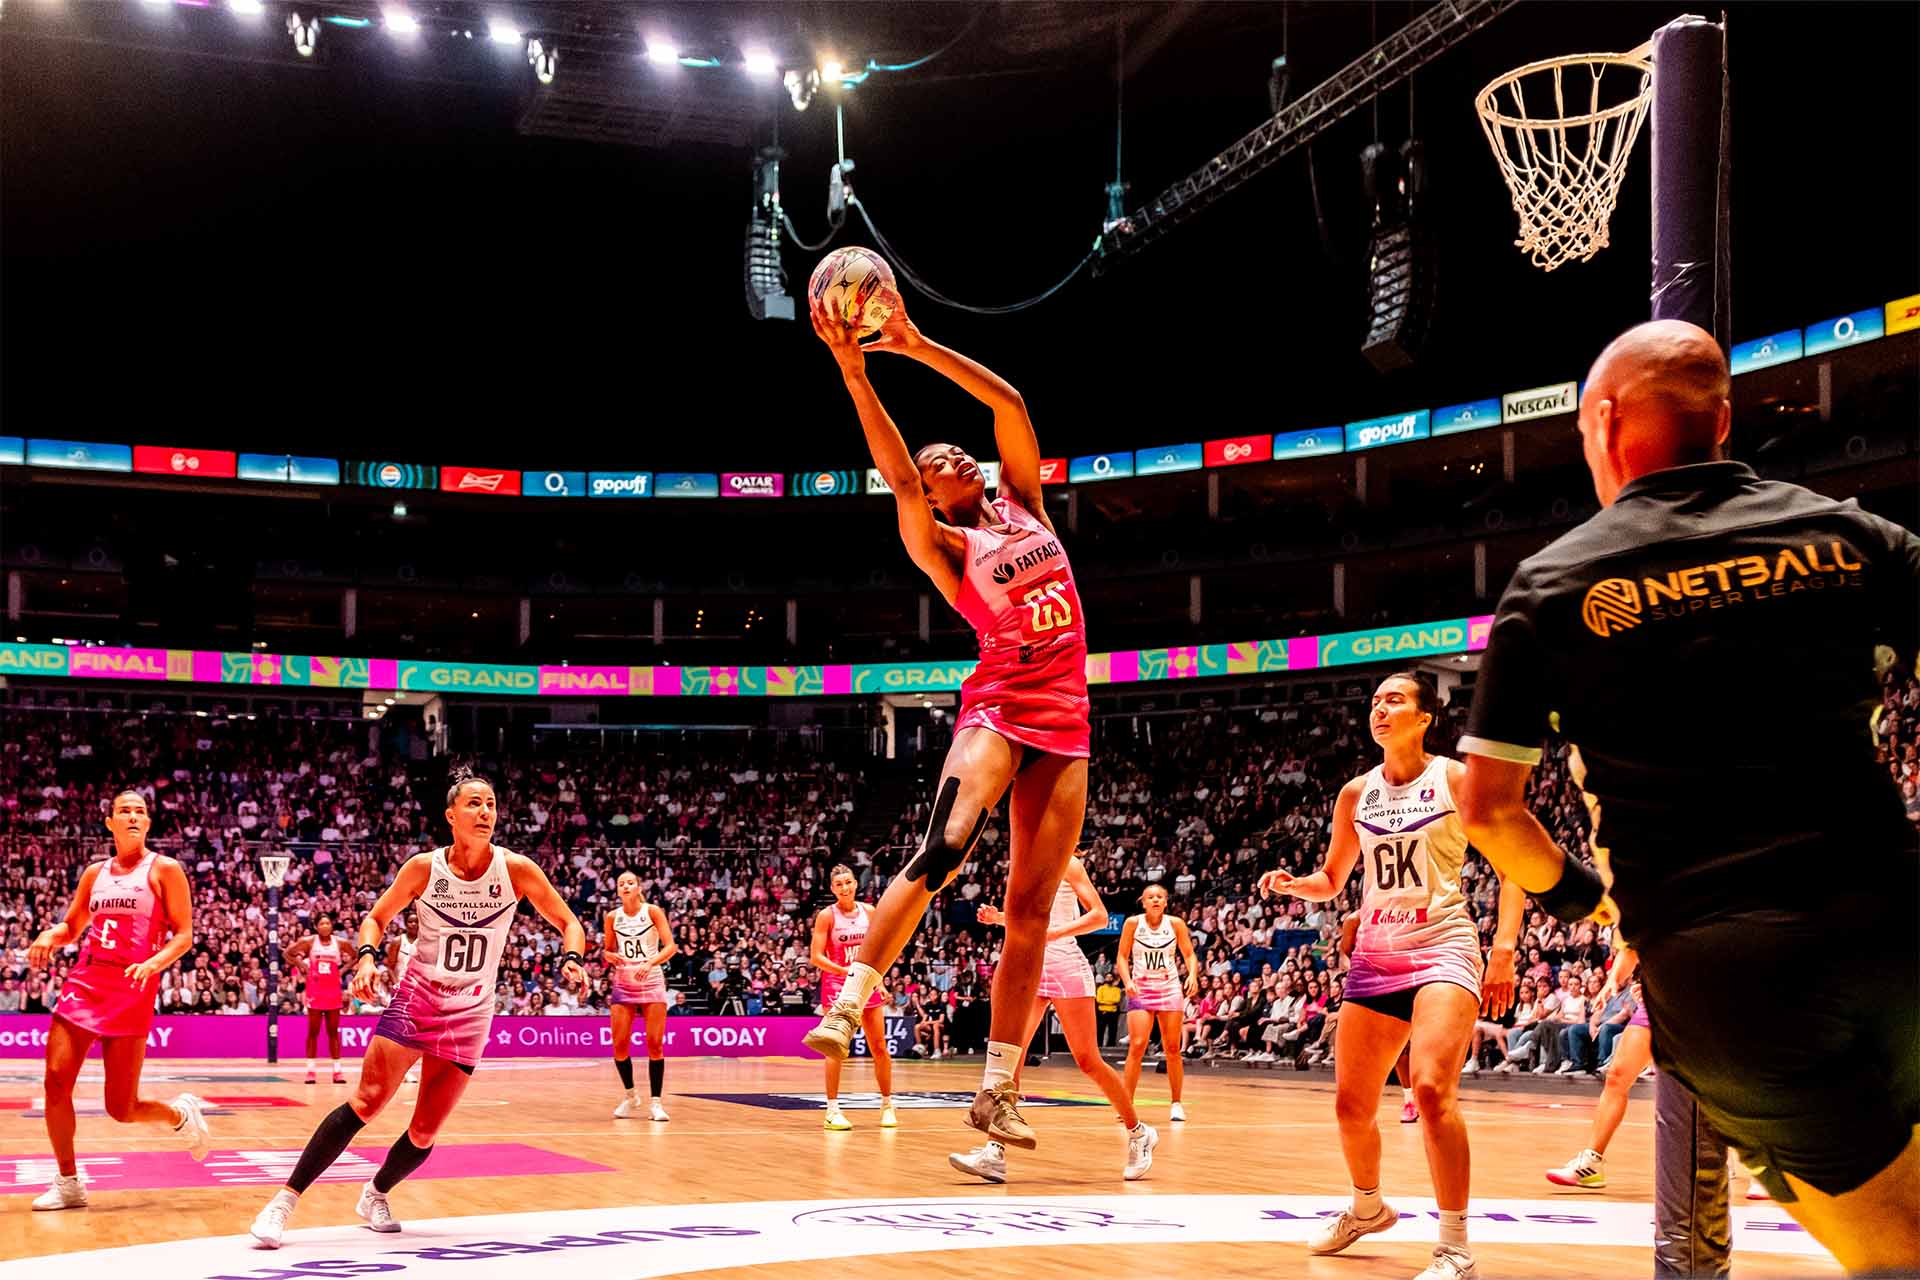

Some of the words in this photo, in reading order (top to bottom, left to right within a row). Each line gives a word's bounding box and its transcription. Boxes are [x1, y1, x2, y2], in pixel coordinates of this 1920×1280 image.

[1358, 414, 1416, 446] gopuff
[544, 472, 568, 496] O2
[593, 475, 647, 494] gopuff
[730, 476, 774, 490] QATAR
[1643, 541, 1862, 606] NETBALL
[1023, 581, 1072, 632] GS
[1651, 592, 1744, 621] SUPER
[1755, 573, 1865, 600] LEAGUE
[1351, 626, 1463, 656] GRAND
[73, 652, 164, 673] FINAL
[430, 668, 535, 688] GRAND
[543, 672, 628, 689] FINAL
[884, 667, 976, 686] GRAN
[1389, 816, 1403, 828] 99
[1374, 840, 1422, 890] GK
[101, 898, 137, 909] FATFACE
[461, 911, 478, 920] 114
[444, 933, 488, 972] GD
[624, 939, 646, 958] GA
[1144, 951, 1166, 970] WA
[338, 1027, 371, 1047] RY
[519, 1026, 593, 1046] Online
[690, 1027, 767, 1046] TODAY
[378, 1225, 761, 1260] SUPER
